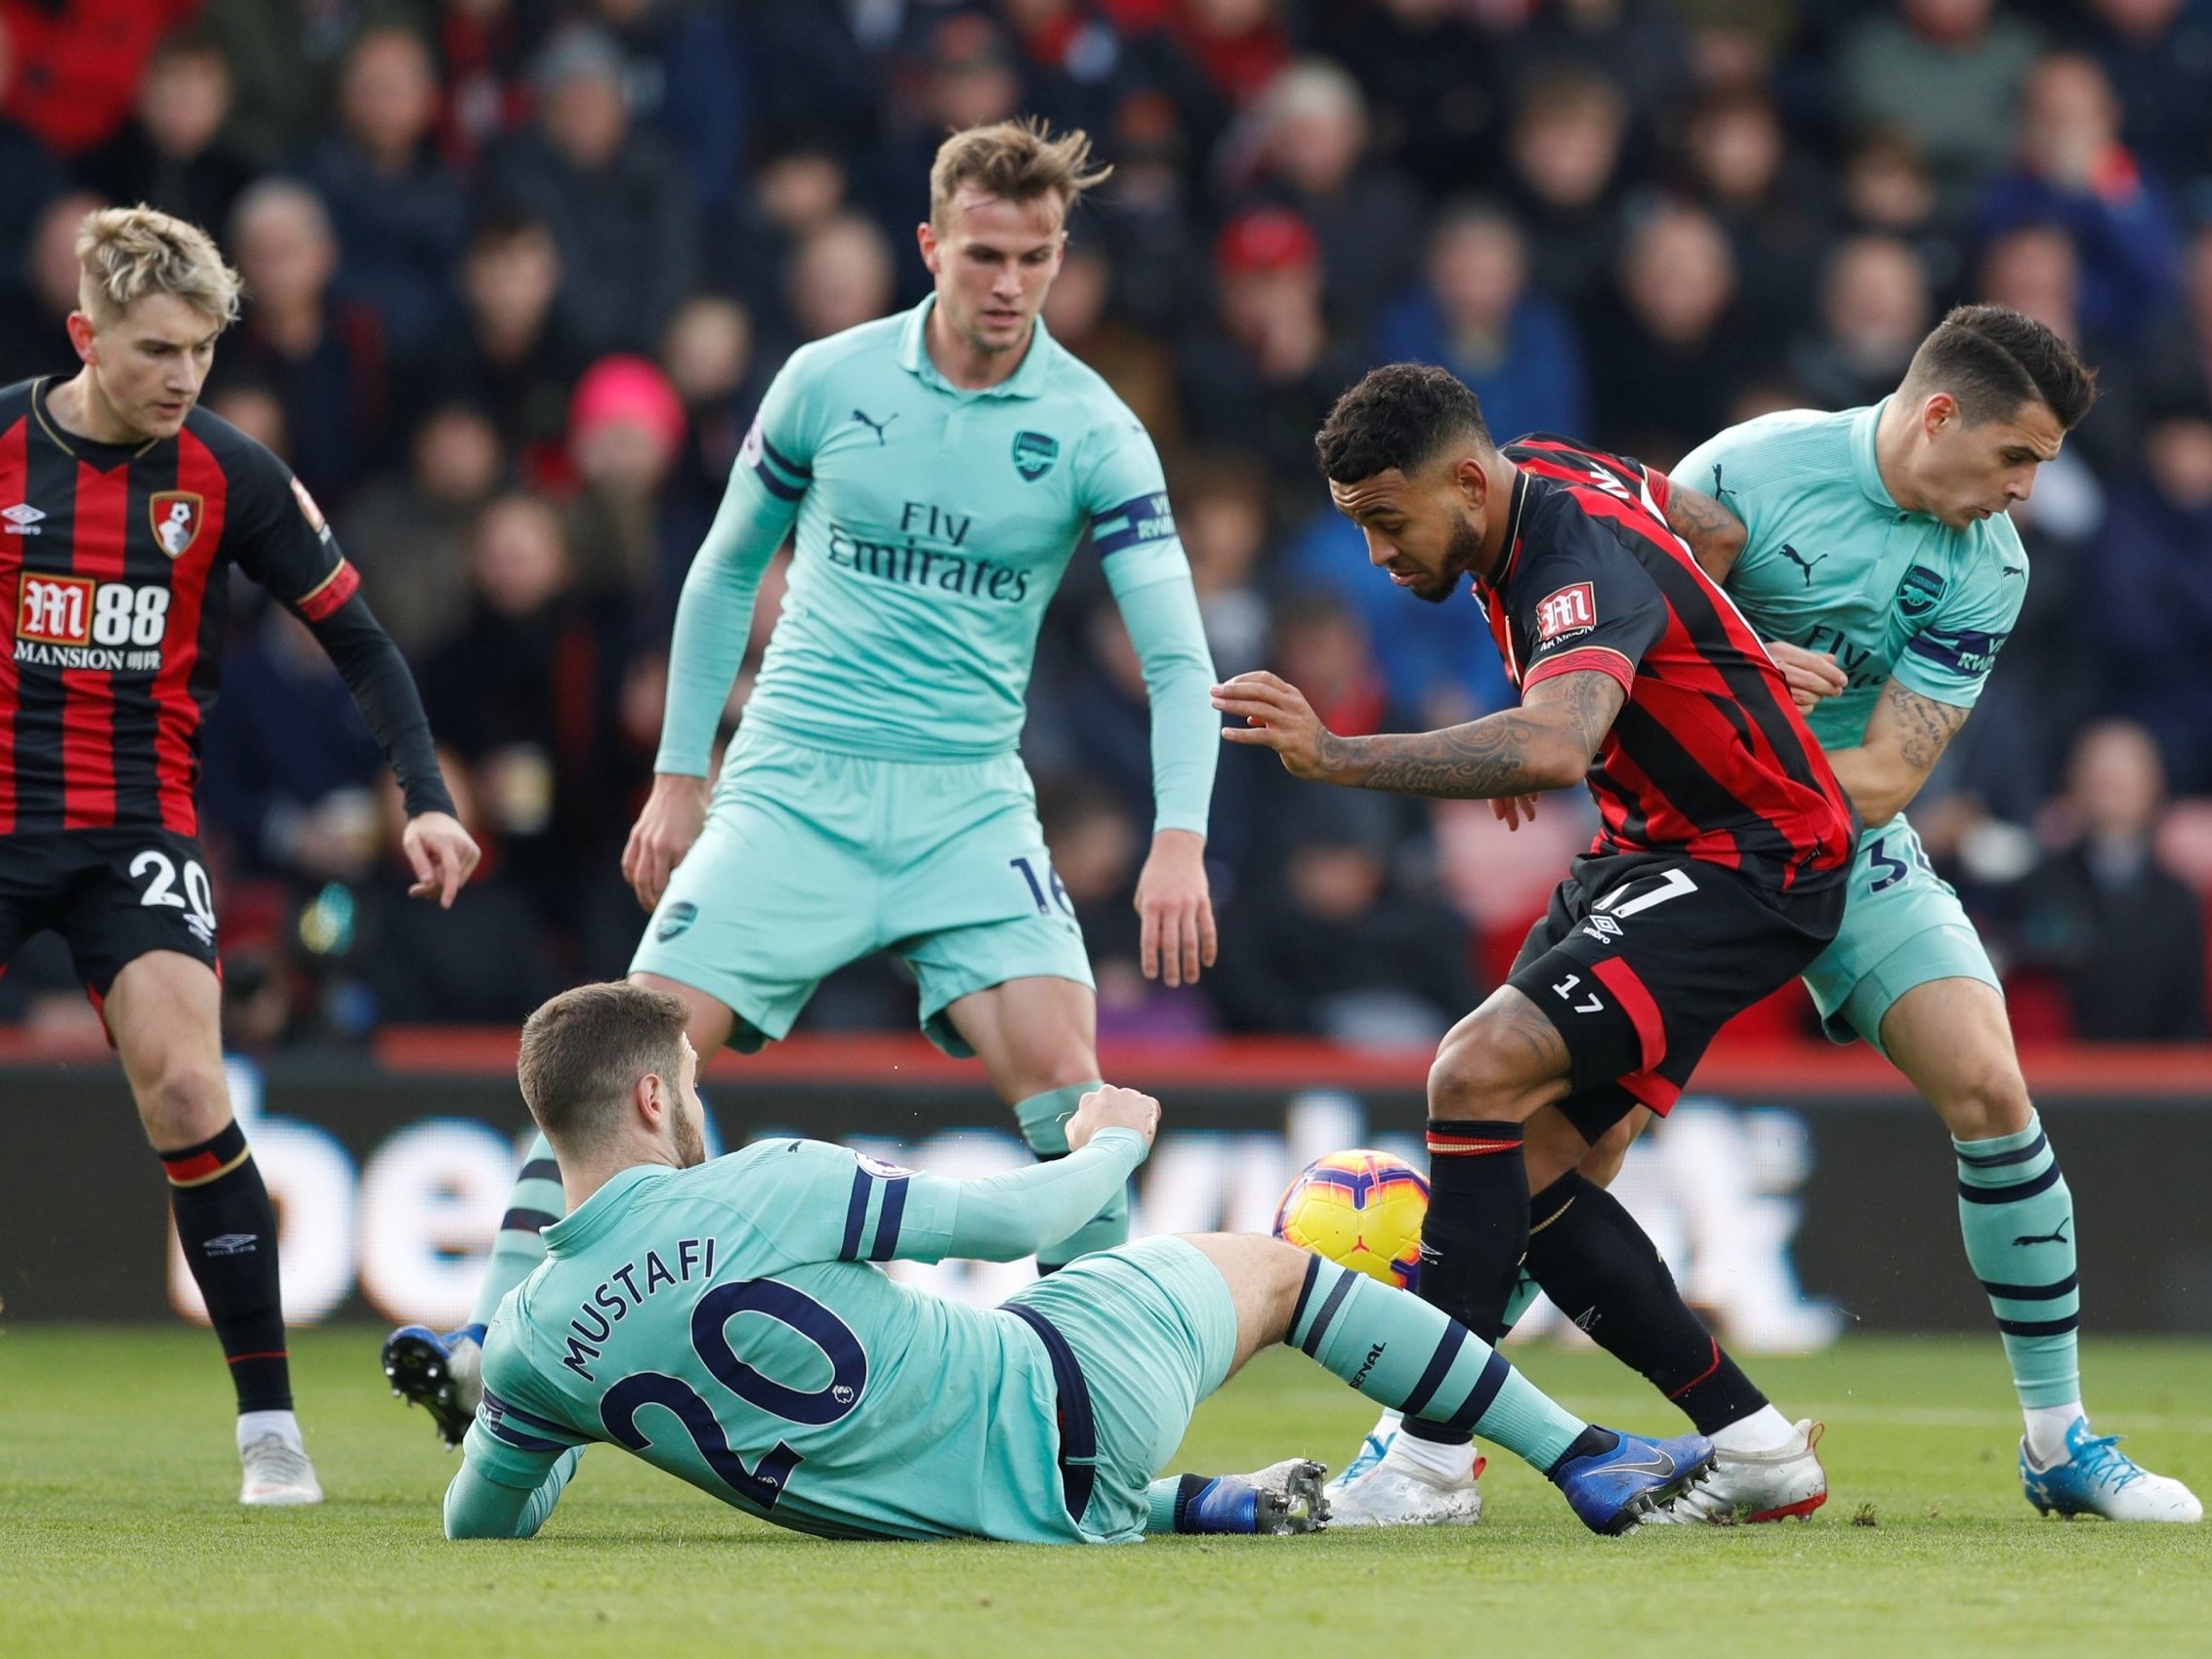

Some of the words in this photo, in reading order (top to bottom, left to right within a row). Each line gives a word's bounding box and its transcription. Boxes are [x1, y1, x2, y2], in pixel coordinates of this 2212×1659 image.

[900, 501, 971, 547] Fly
[828, 522, 1031, 602] Emirates
[13, 640, 124, 671] MANSION
[129, 850, 217, 931] 20
[1582, 926, 1611, 945] umbro
[1551, 974, 1605, 1014] 17
[563, 1236, 716, 1383] MUSTAFI
[599, 1277, 869, 1511] 20
